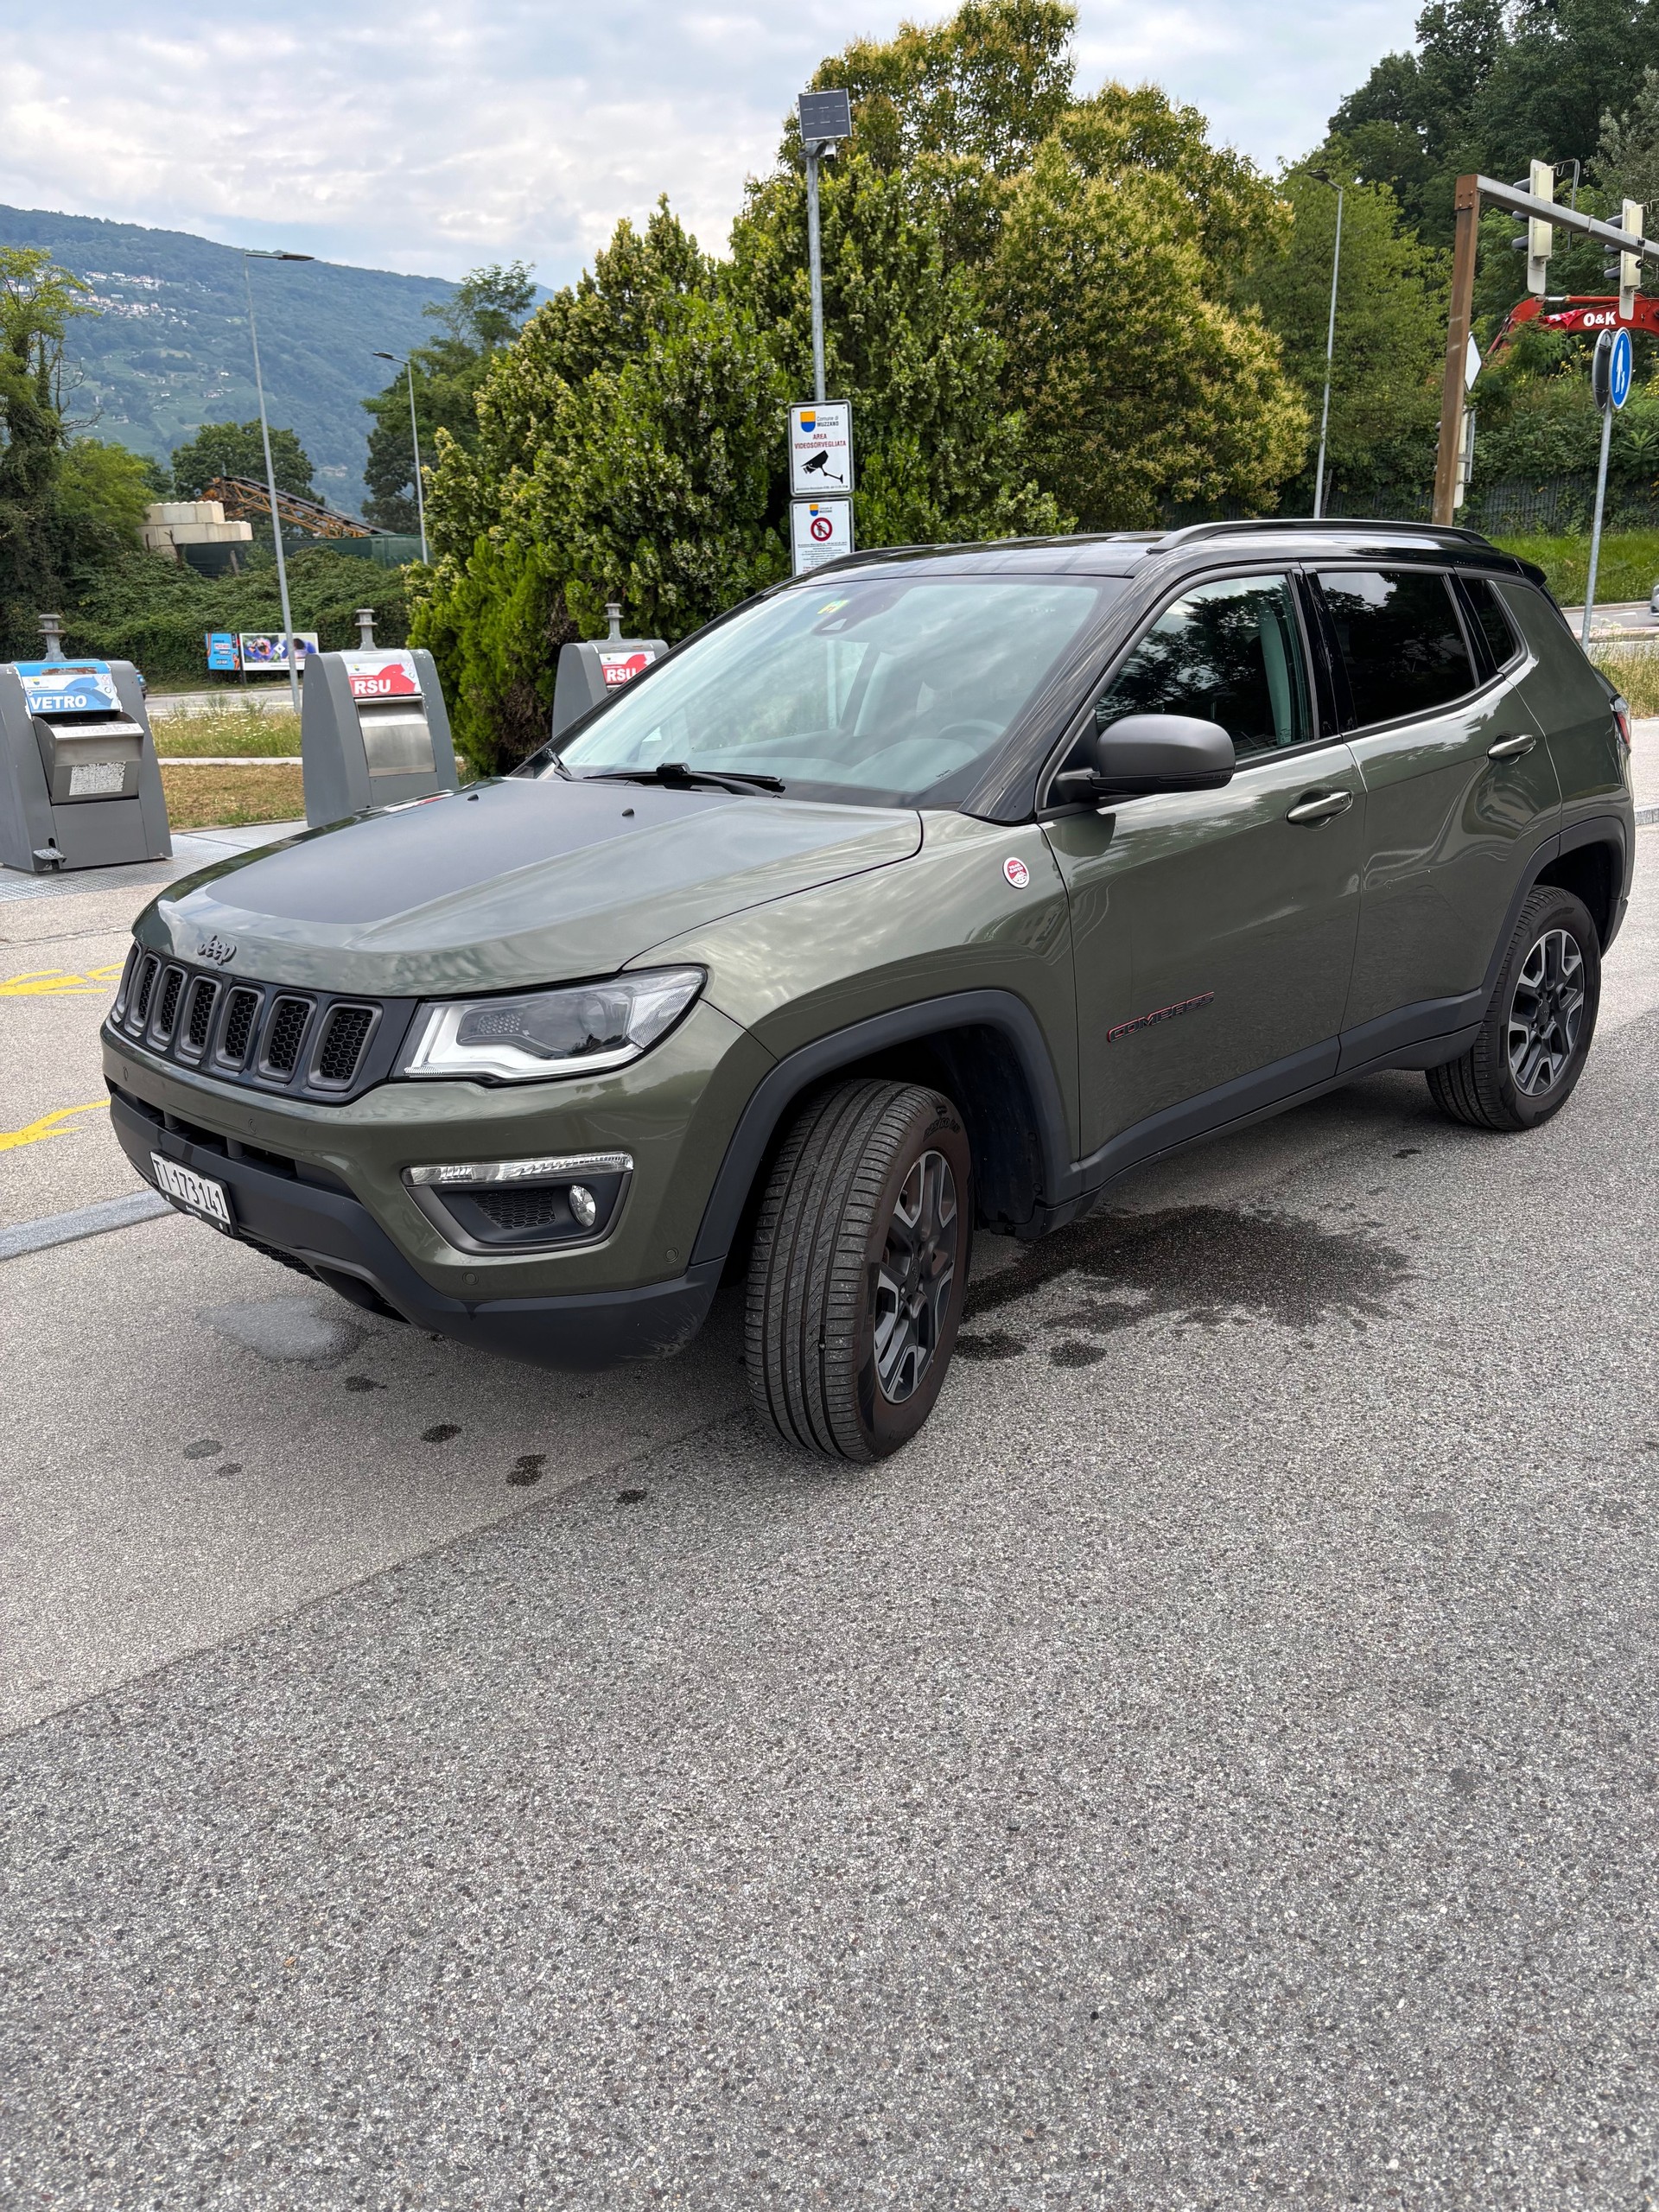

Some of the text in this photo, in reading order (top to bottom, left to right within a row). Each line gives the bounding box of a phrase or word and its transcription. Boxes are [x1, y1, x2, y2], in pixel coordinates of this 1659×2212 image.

[1583, 311, 1617, 327] O&K
[794, 441, 847, 449] VIDEOSORVEGLIATA
[607, 667, 637, 682] RSU
[353, 679, 391, 695] RSU
[30, 695, 87, 710] VETRO
[197, 935, 237, 966] Jeep
[1107, 991, 1215, 1043] COMPASS
